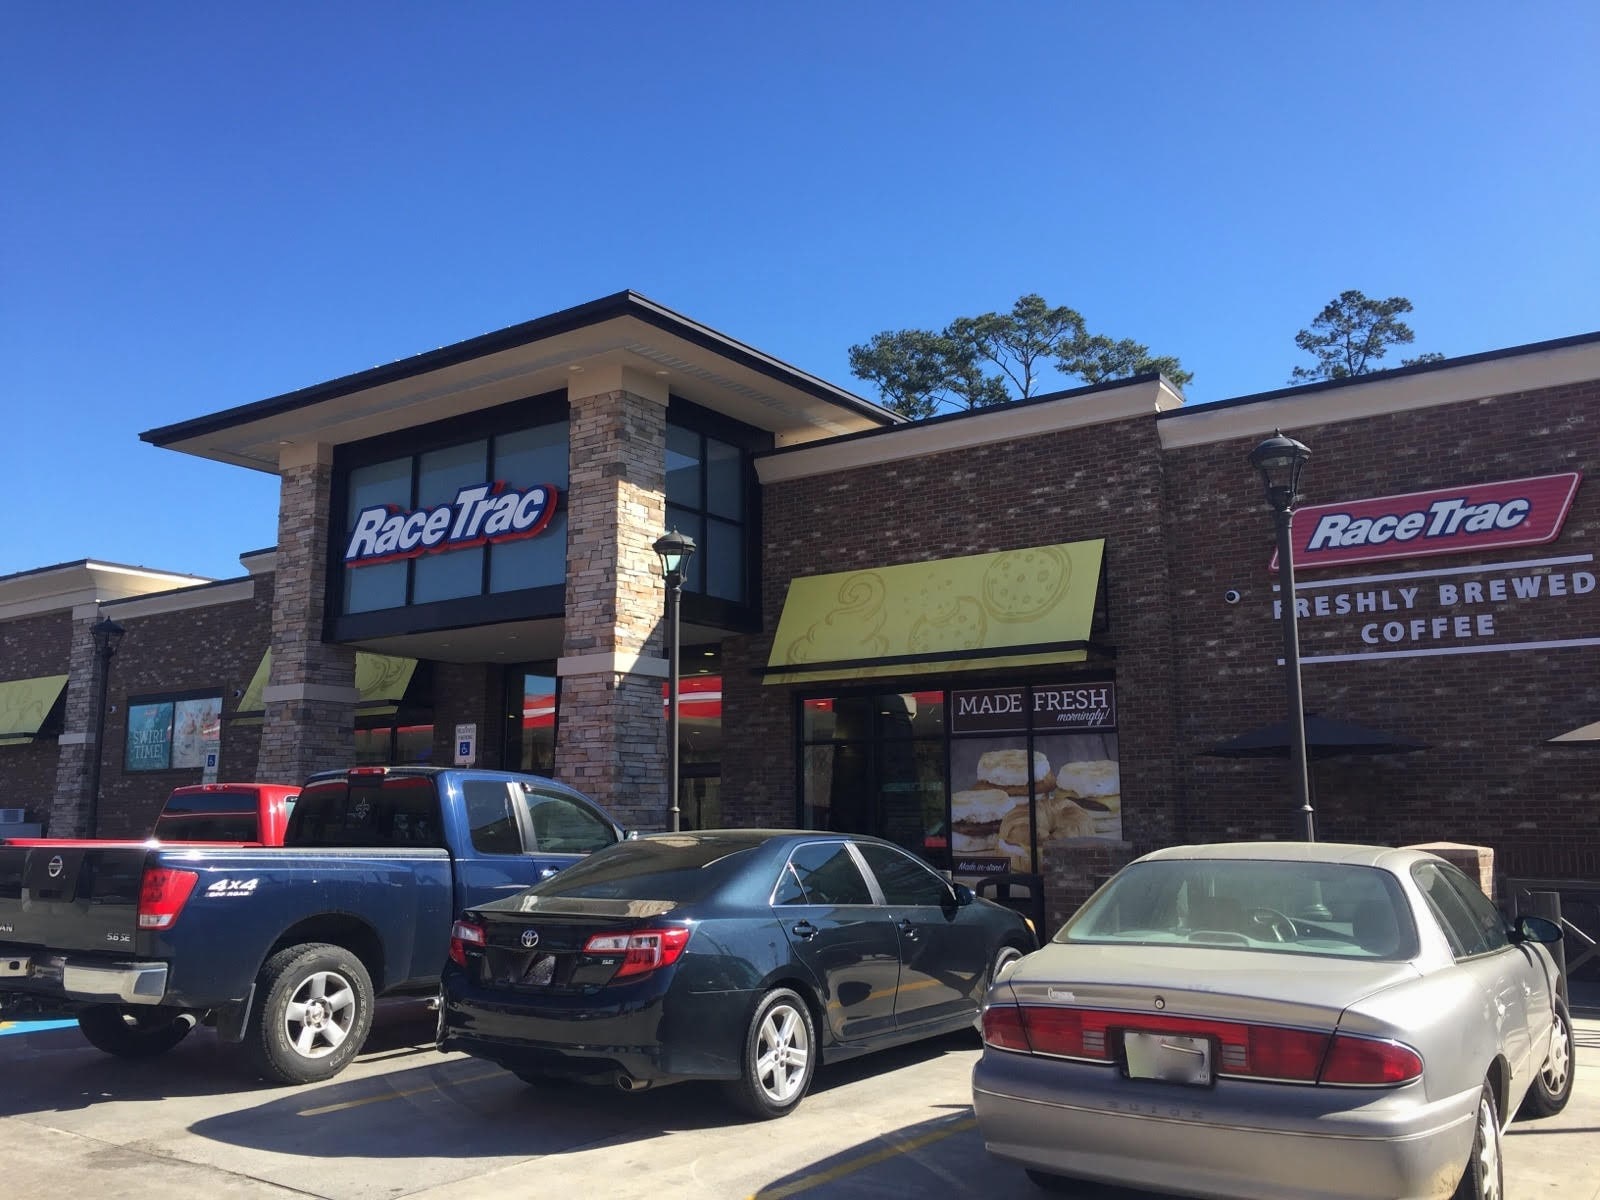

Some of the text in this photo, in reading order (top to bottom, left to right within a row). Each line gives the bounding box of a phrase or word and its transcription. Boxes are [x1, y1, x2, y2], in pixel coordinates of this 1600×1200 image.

[345, 485, 547, 560] RaceTrac
[1306, 498, 1532, 551] RaceTrac
[1439, 571, 1596, 606] BREWED
[1361, 614, 1495, 644] COFFEE
[958, 688, 1109, 716] MADE FRESH
[1057, 708, 1111, 727] morningly!
[134, 729, 166, 745] SWIRL
